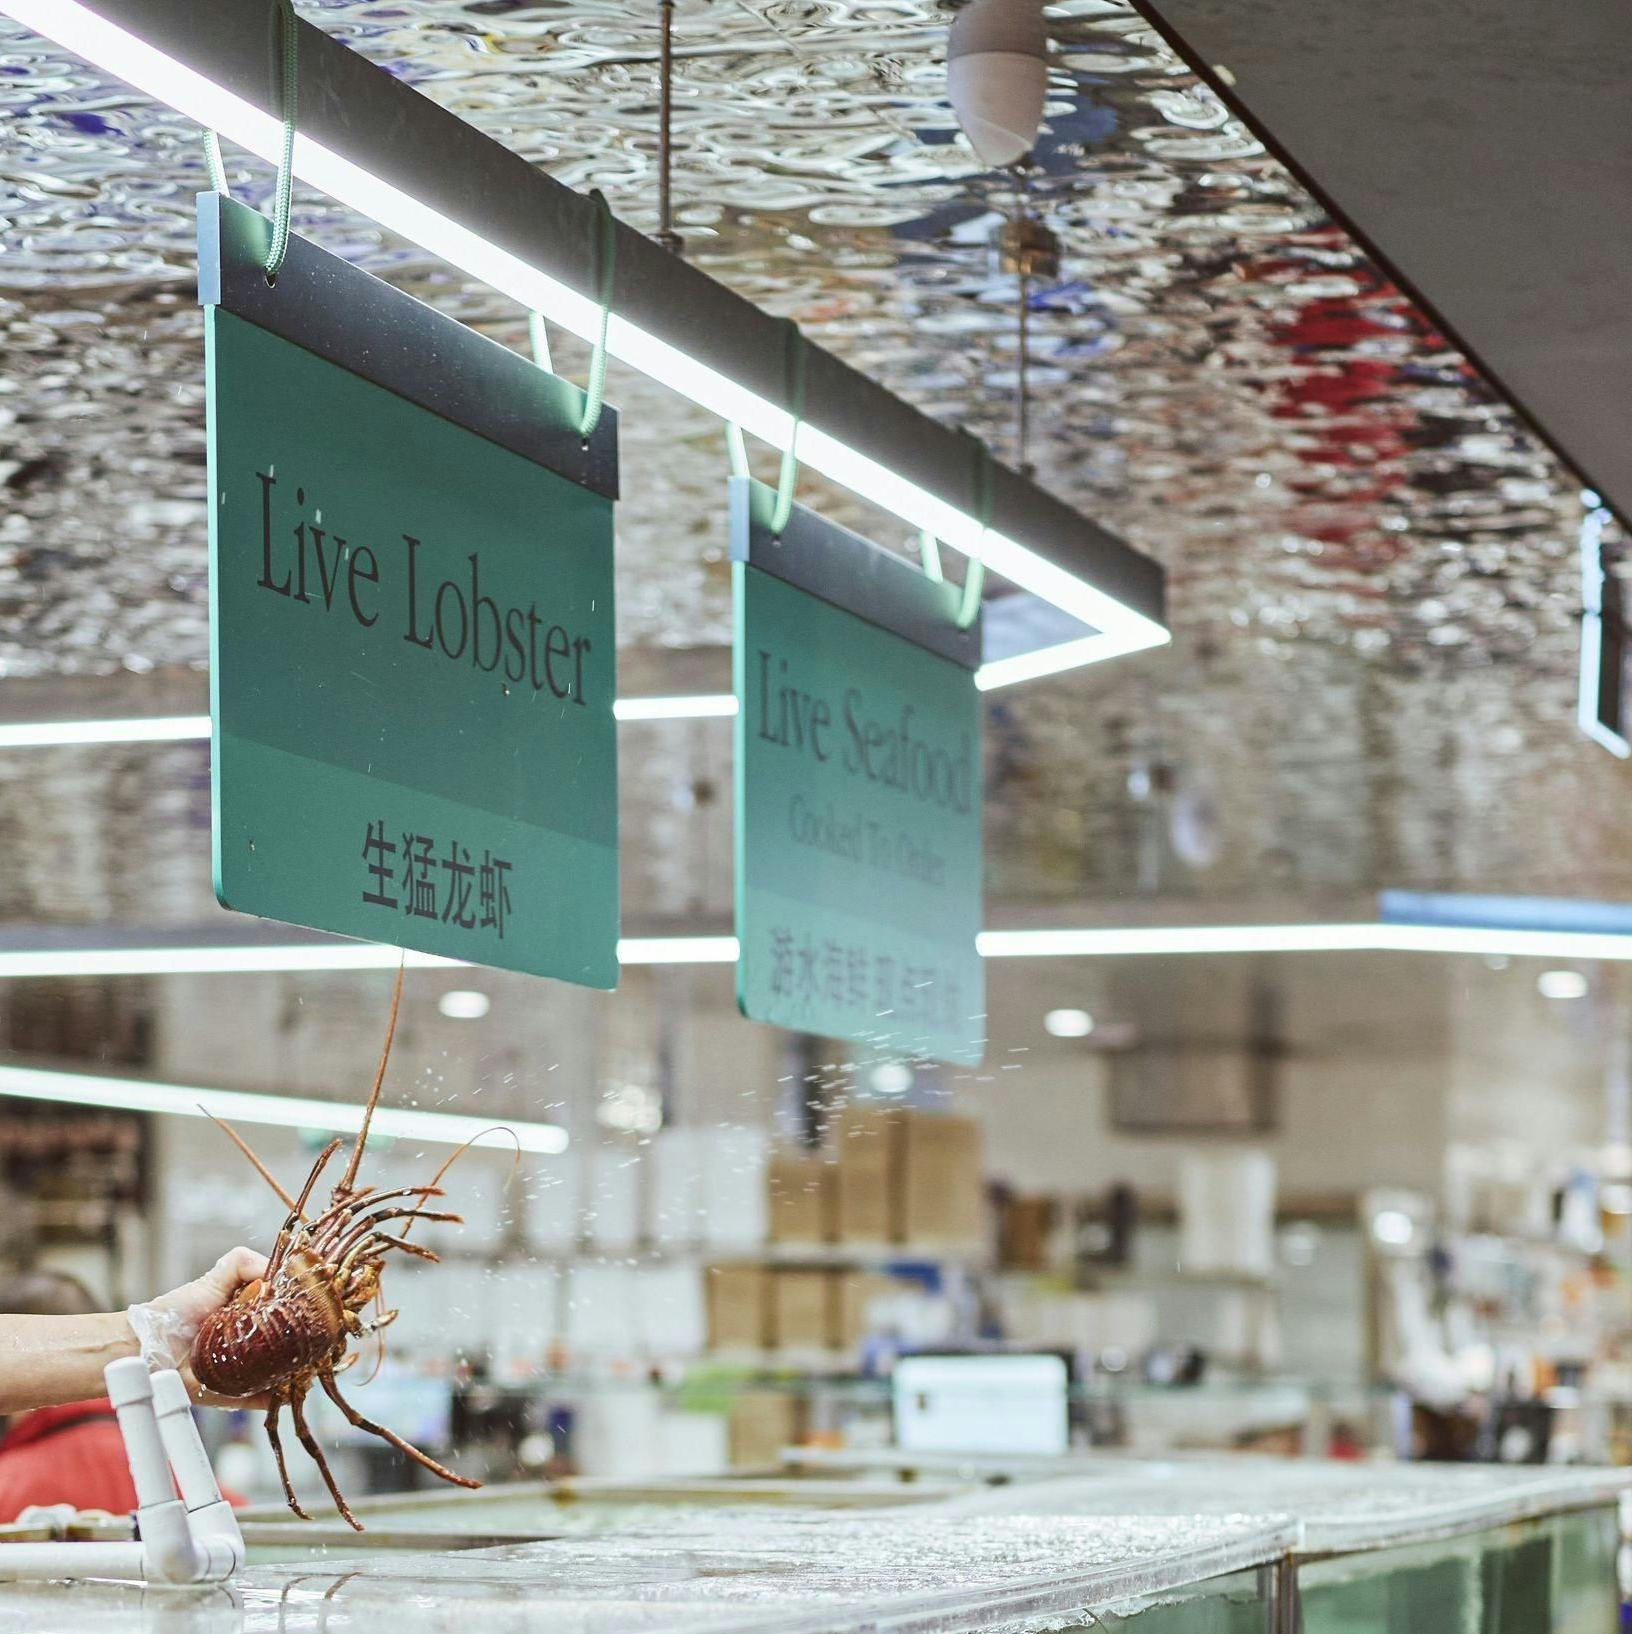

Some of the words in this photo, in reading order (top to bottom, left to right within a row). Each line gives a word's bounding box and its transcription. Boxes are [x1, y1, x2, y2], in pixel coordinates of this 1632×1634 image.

[255, 471, 380, 628] Live
[402, 533, 592, 707] Lobster
[758, 650, 831, 762] Live
[842, 686, 972, 816] Seafood
[362, 820, 512, 939] 生猛龙虾
